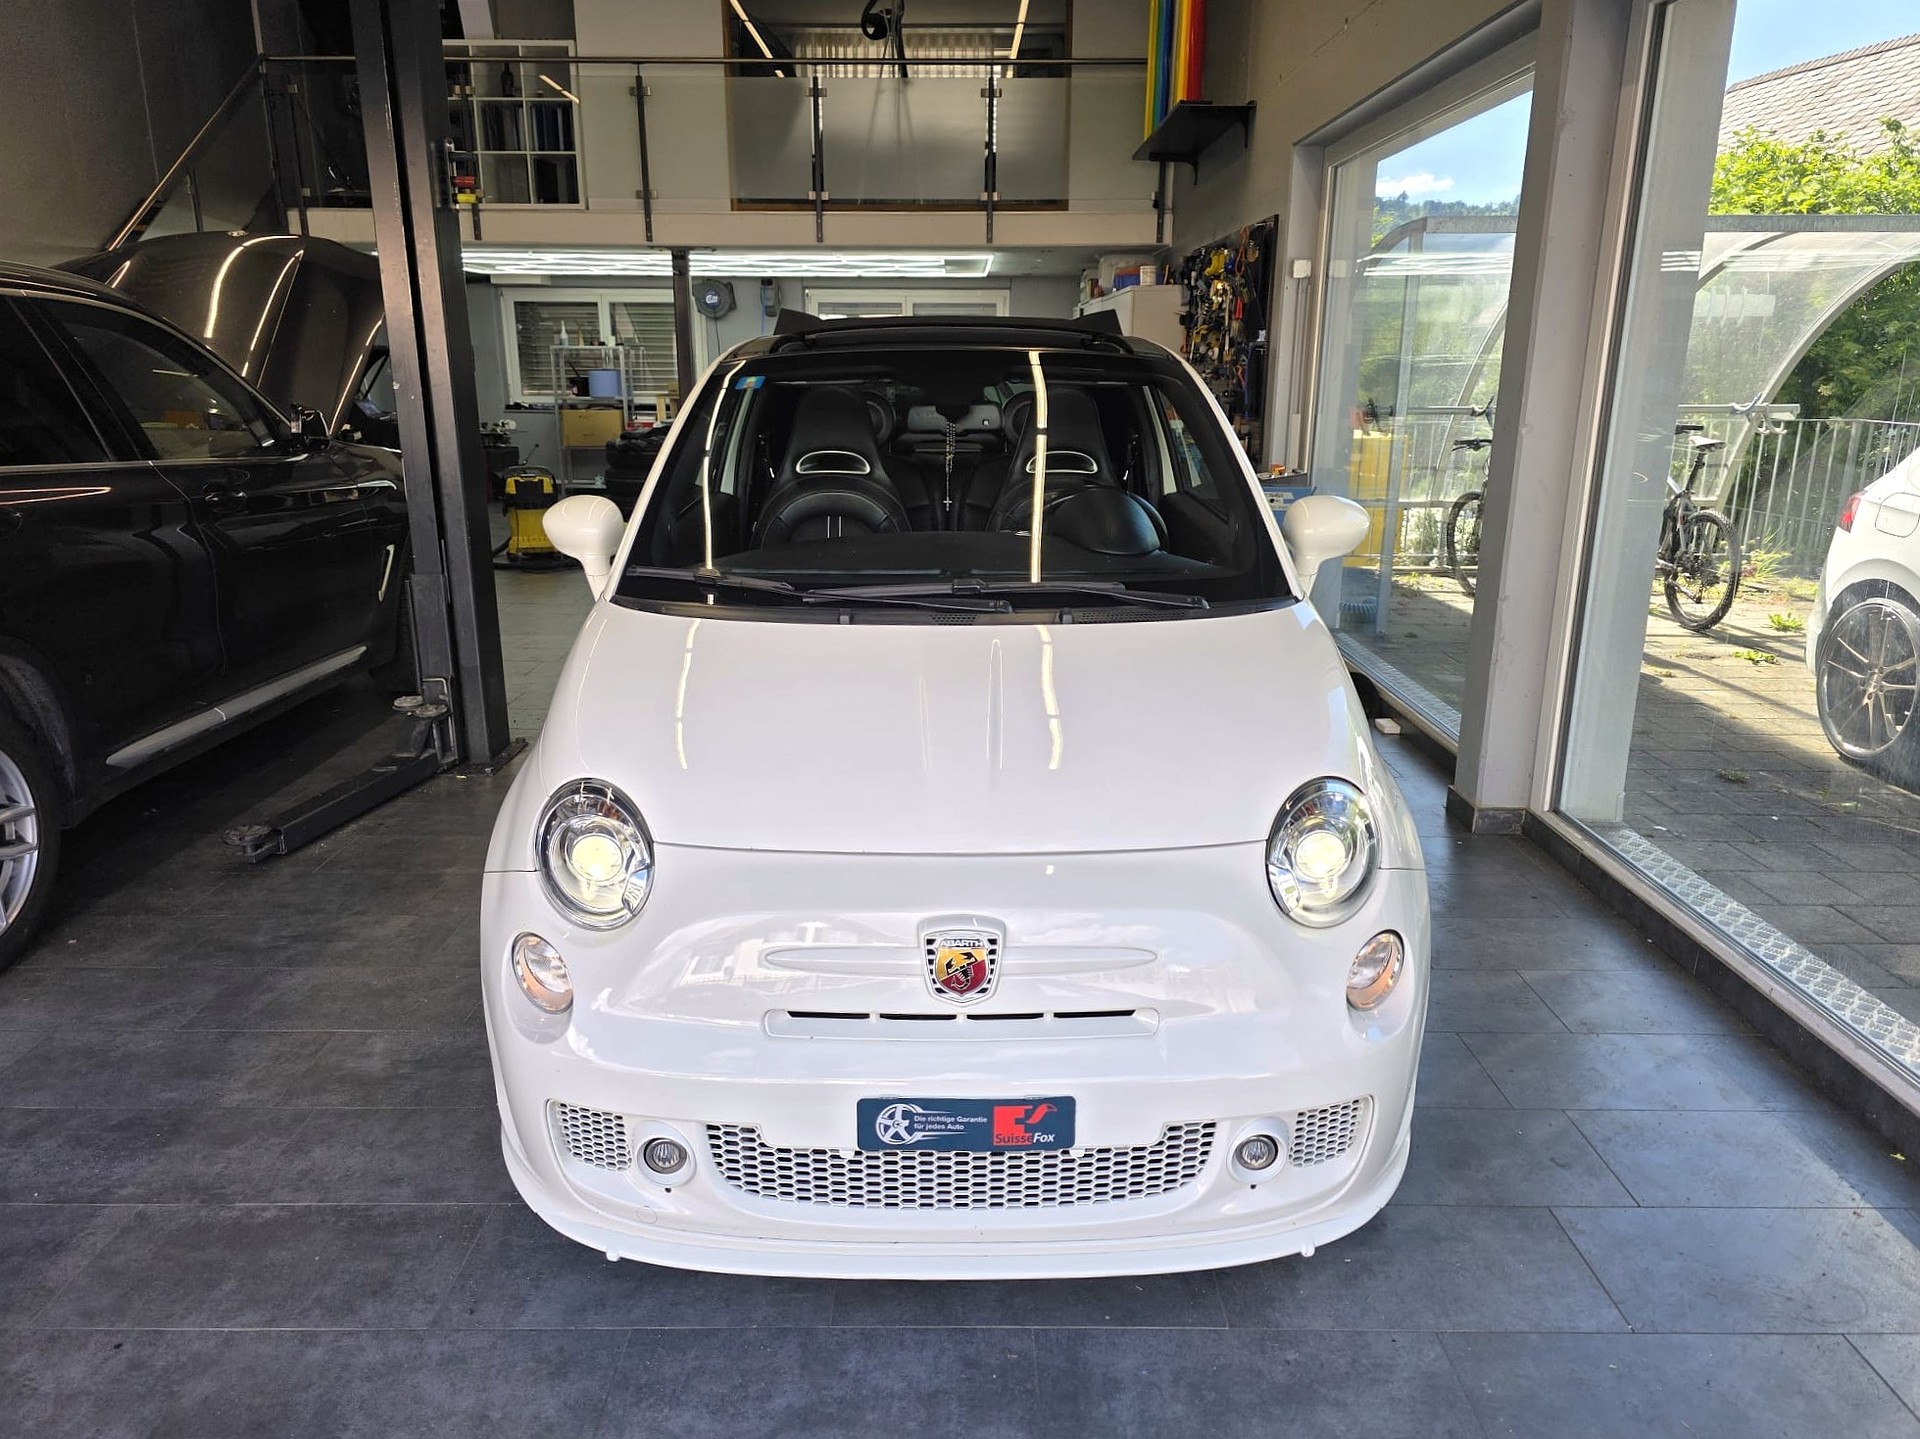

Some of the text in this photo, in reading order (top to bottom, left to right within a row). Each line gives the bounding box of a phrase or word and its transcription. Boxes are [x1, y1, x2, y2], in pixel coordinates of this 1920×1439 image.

[928, 1115, 955, 1123] richtige
[956, 1115, 988, 1123] Garantie
[995, 1133, 1055, 1144] SuisseFox
